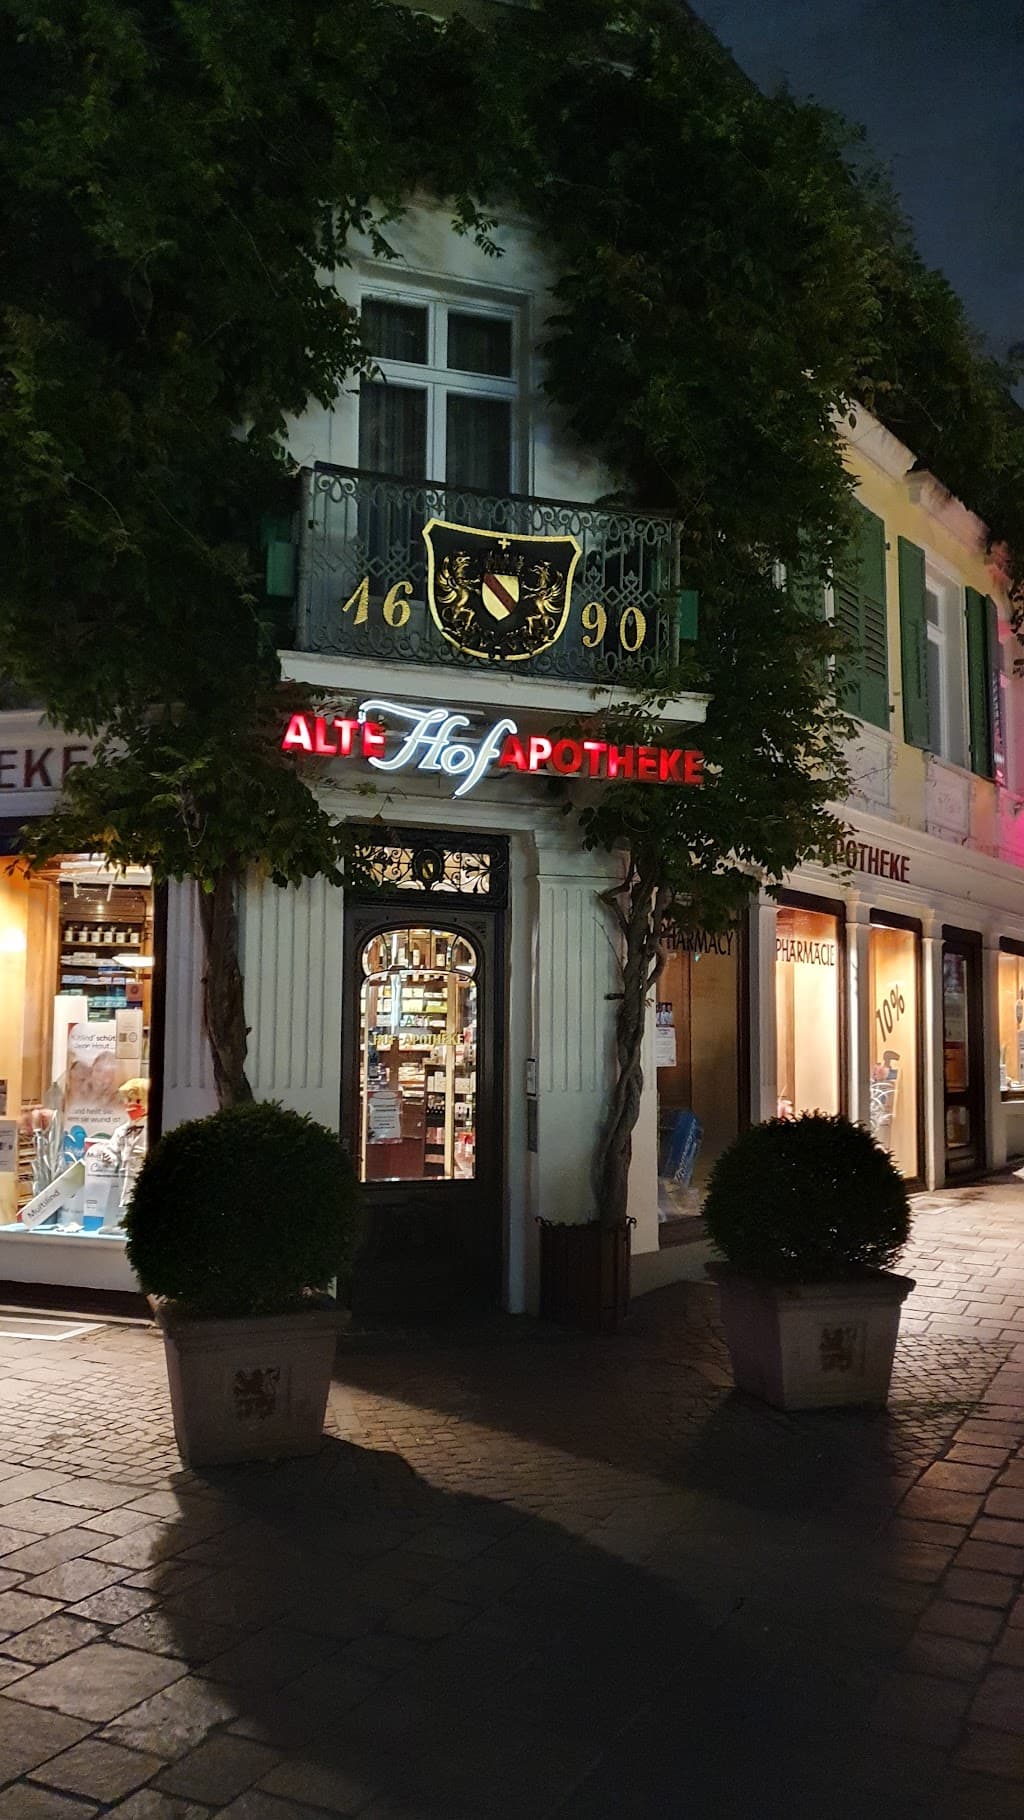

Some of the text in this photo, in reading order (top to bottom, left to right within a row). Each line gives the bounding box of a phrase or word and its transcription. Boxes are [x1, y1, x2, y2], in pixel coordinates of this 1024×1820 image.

[281, 700, 705, 797] ALTE Hof APOTHEKE
[776, 938, 836, 967] PHARMACIE
[876, 984, 905, 1042] 10%
[27, 1189, 61, 1217] Multilind
